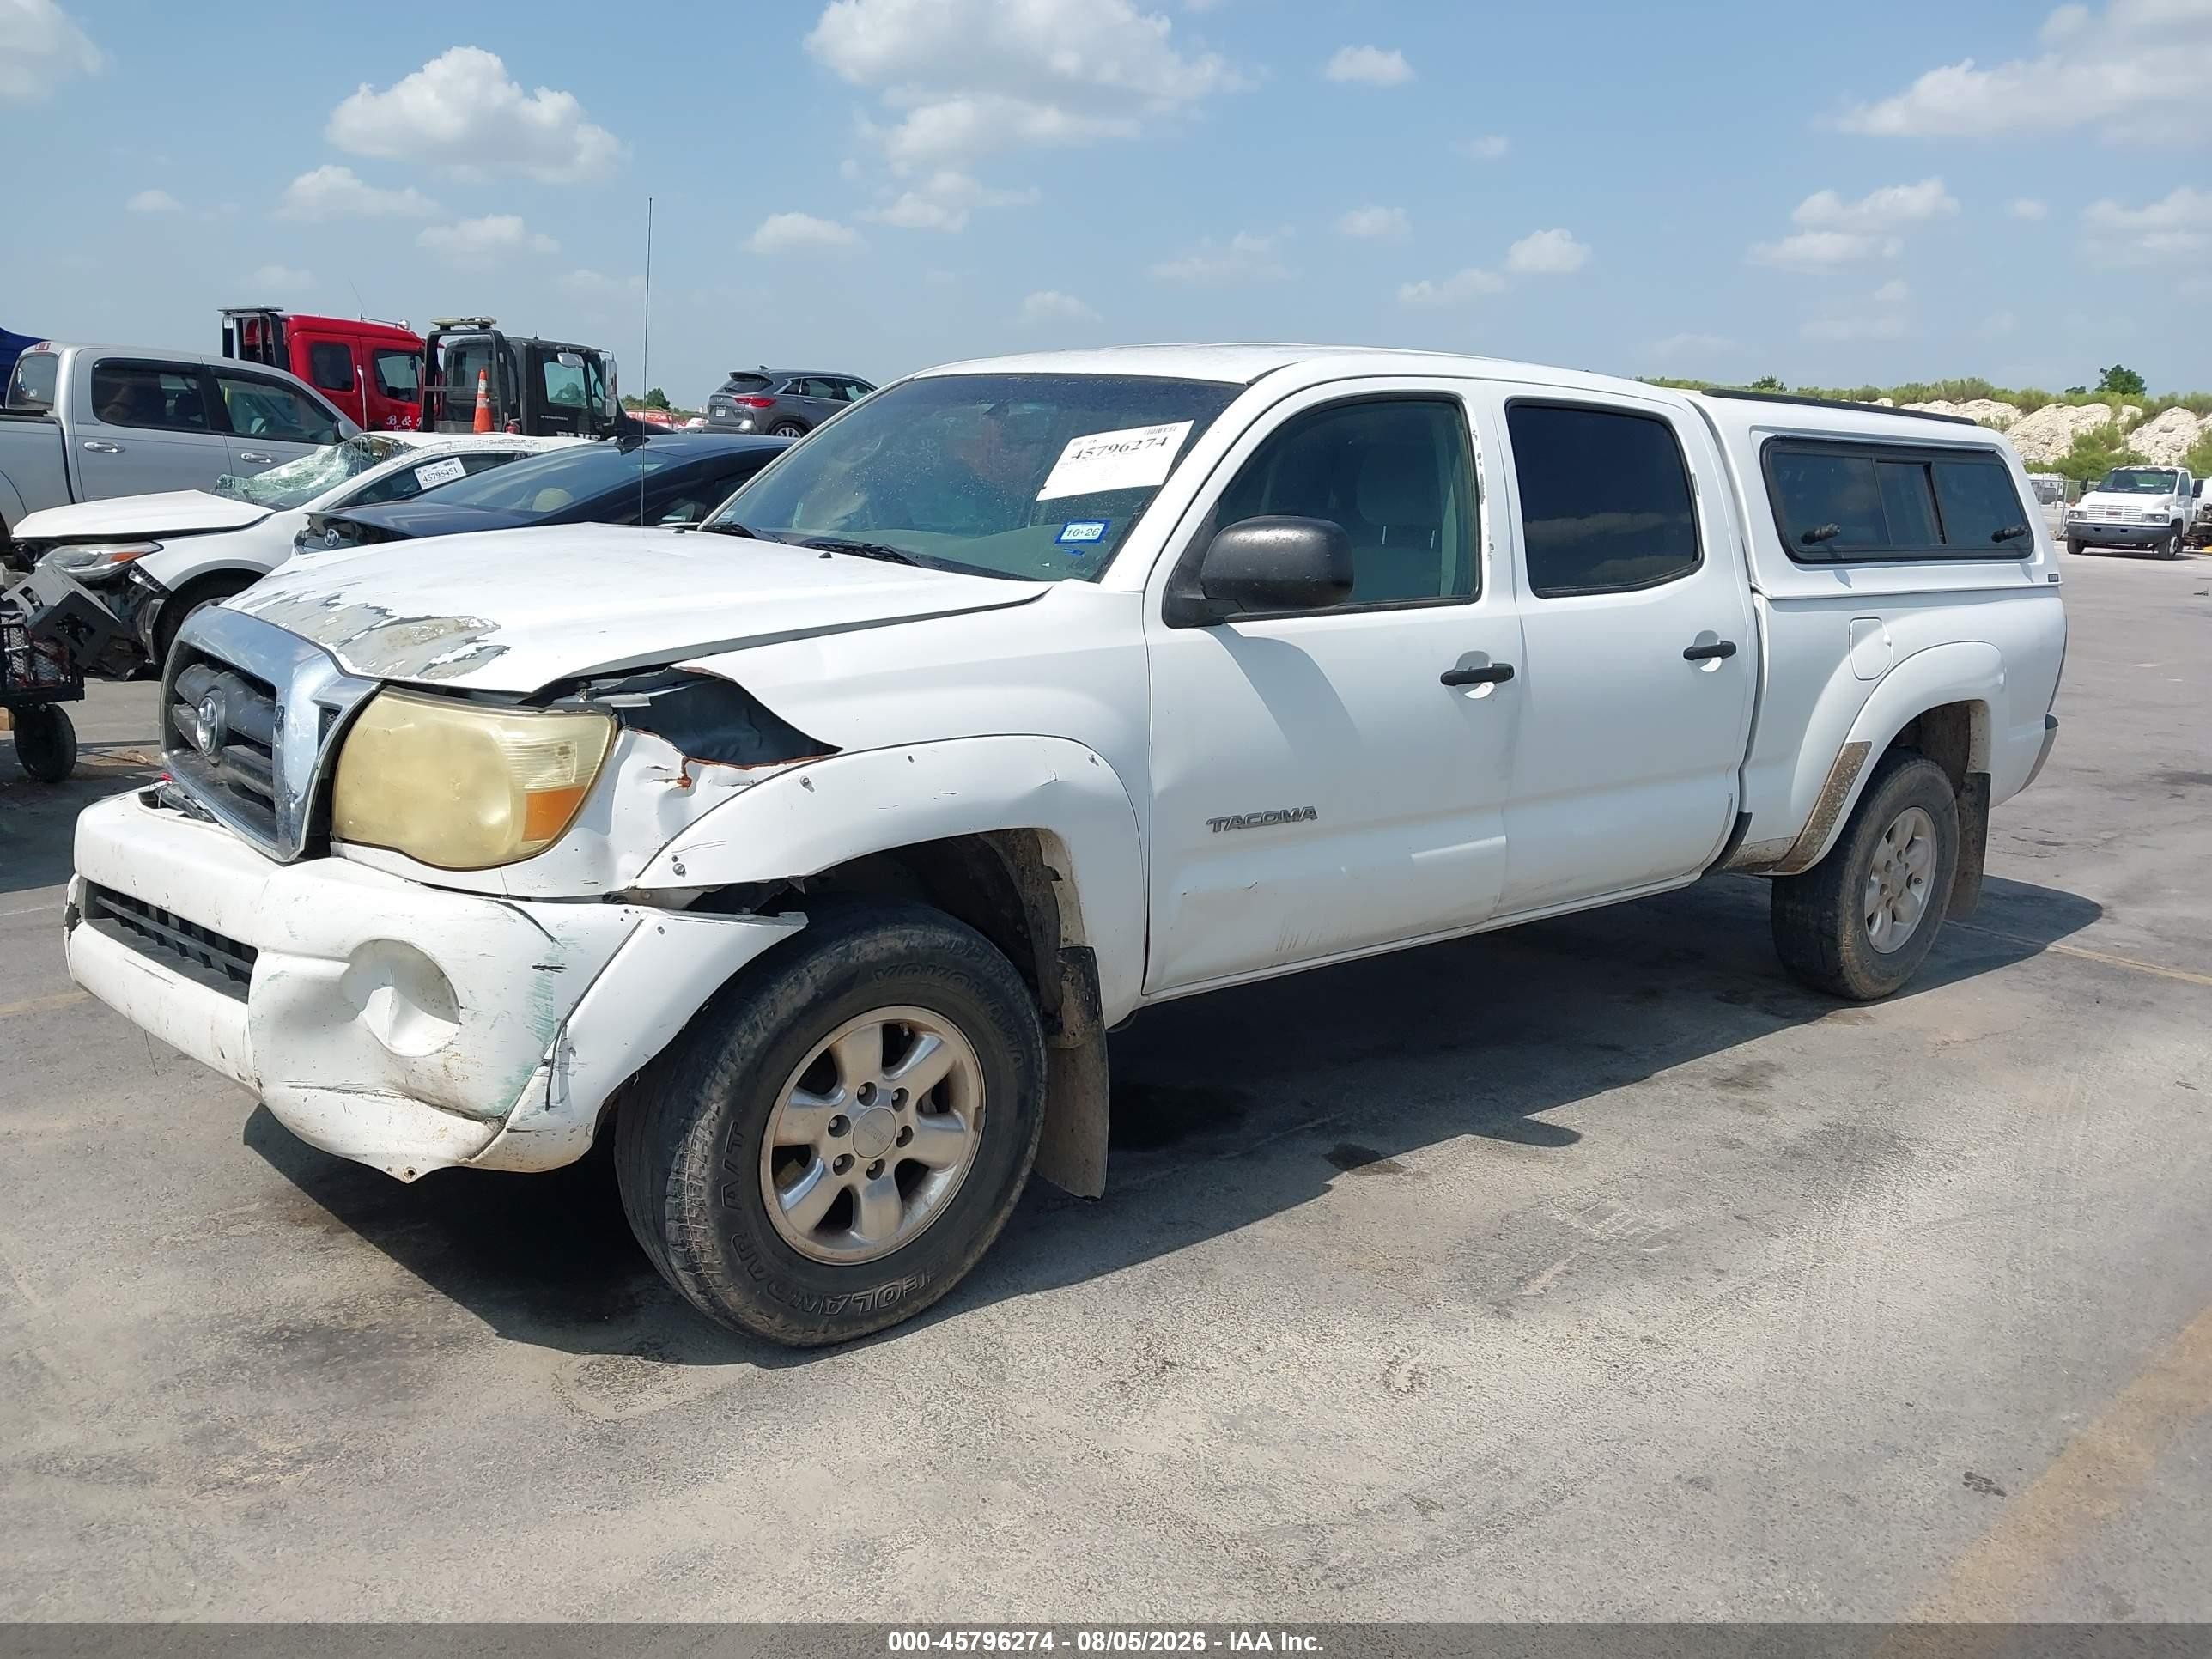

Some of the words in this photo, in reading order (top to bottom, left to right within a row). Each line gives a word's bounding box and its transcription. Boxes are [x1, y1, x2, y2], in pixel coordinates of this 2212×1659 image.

[386, 415, 397, 426] B
[401, 415, 412, 427] &
[1071, 436, 1169, 460] 45796274
[1206, 805, 1318, 833] TACOMA
